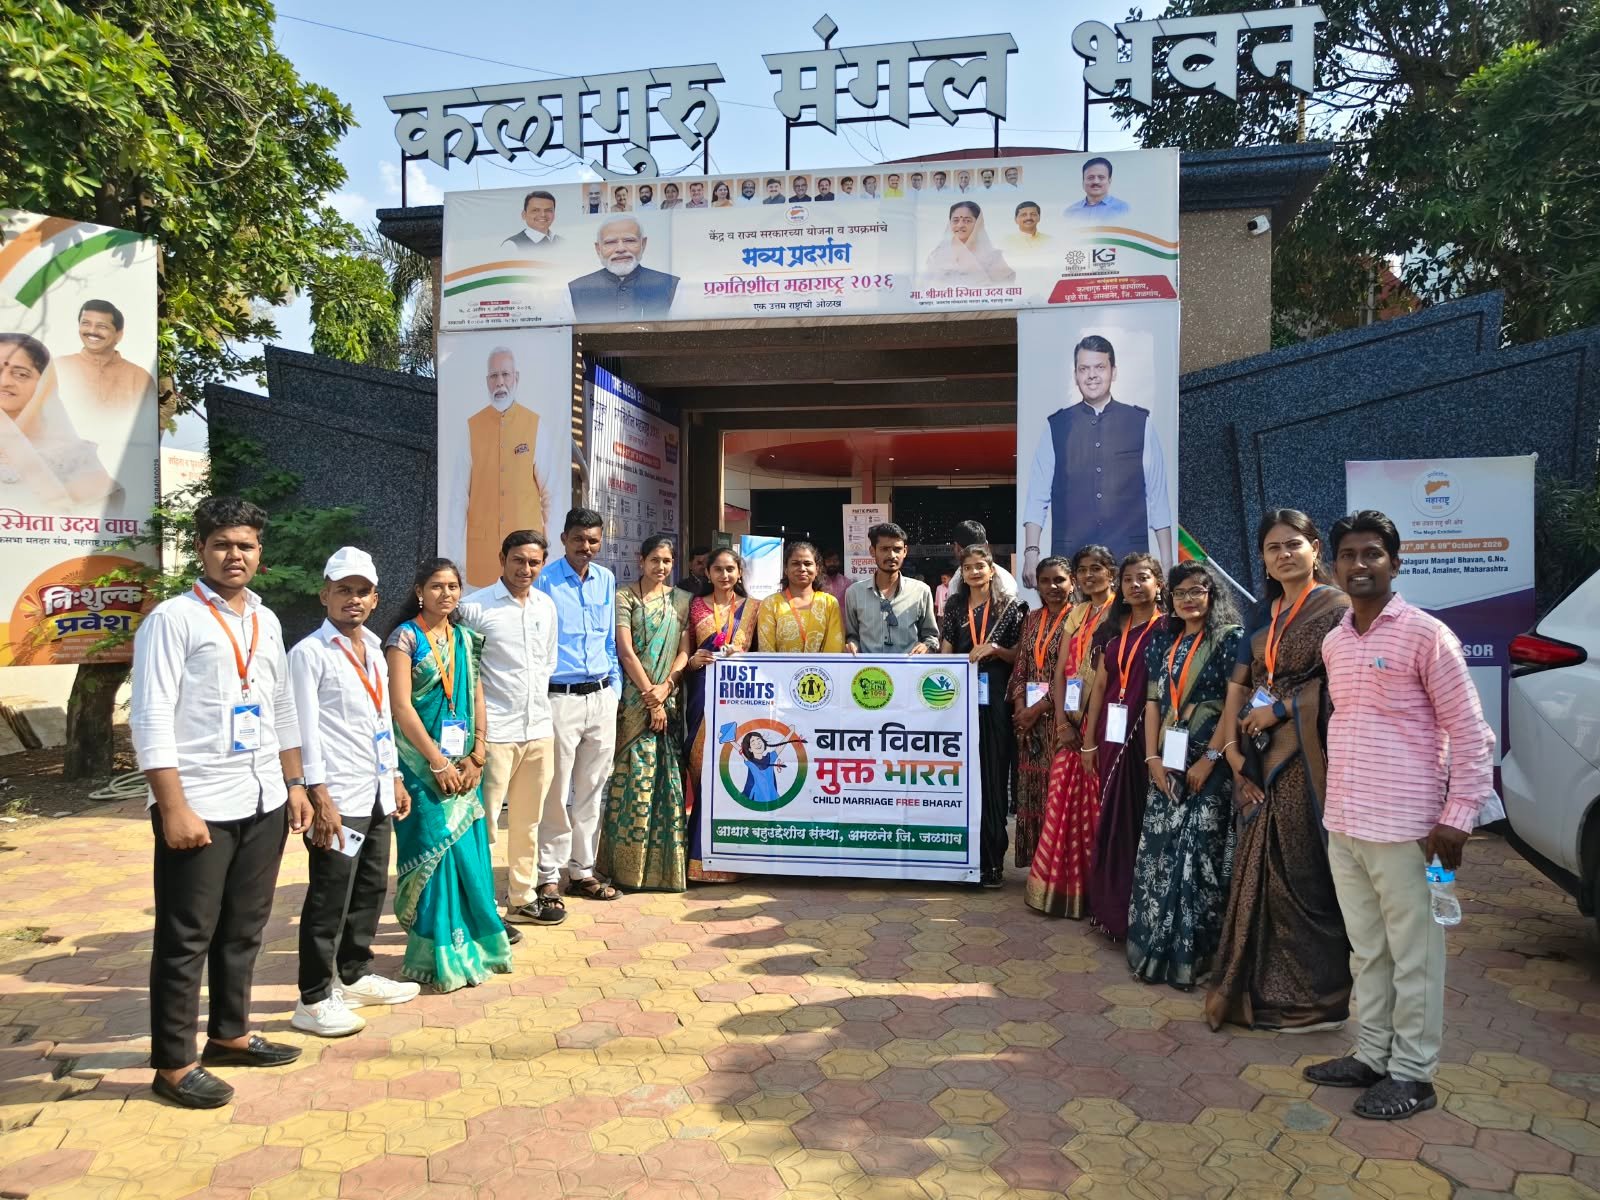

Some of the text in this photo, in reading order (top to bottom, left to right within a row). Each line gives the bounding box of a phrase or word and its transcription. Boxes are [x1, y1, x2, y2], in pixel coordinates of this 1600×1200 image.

[384, 5, 1327, 180] कलागुरु मंगल भवन
[709, 222, 888, 242] केंद्र व राज्य सरकारच्या योजना व उपक्रमांचे
[742, 237, 852, 267] भव्य प्रदर्शन
[704, 273, 894, 295] प्रगतिशील महाराष्ट्र २०२६
[925, 287, 954, 299] श्रीमती
[955, 286, 982, 298] स्मिता
[984, 287, 1003, 297] उदय
[1005, 287, 1022, 296] वाघ
[753, 298, 842, 311] एक उत्तम राष्ट्राची ओळख
[60, 516, 100, 533] उदय
[104, 519, 139, 534] वाघ
[26, 537, 51, 545] मतदार
[1431, 557, 1456, 565] Mangal
[1412, 567, 1431, 575] Road,
[55, 613, 131, 635] प्रवेश
[720, 665, 758, 681] JUST
[720, 682, 774, 699] RIGHTS
[814, 722, 962, 757] बाल विवाह
[813, 758, 963, 795] मुक्त भारत
[813, 796, 963, 808] CHILD MARRIAGE FREE BHARAT
[716, 826, 750, 838] आधार
[809, 827, 844, 842] संस्था,
[848, 829, 893, 842] अमळनेर
[895, 829, 915, 843] जि.
[919, 832, 962, 845] जळगाव
